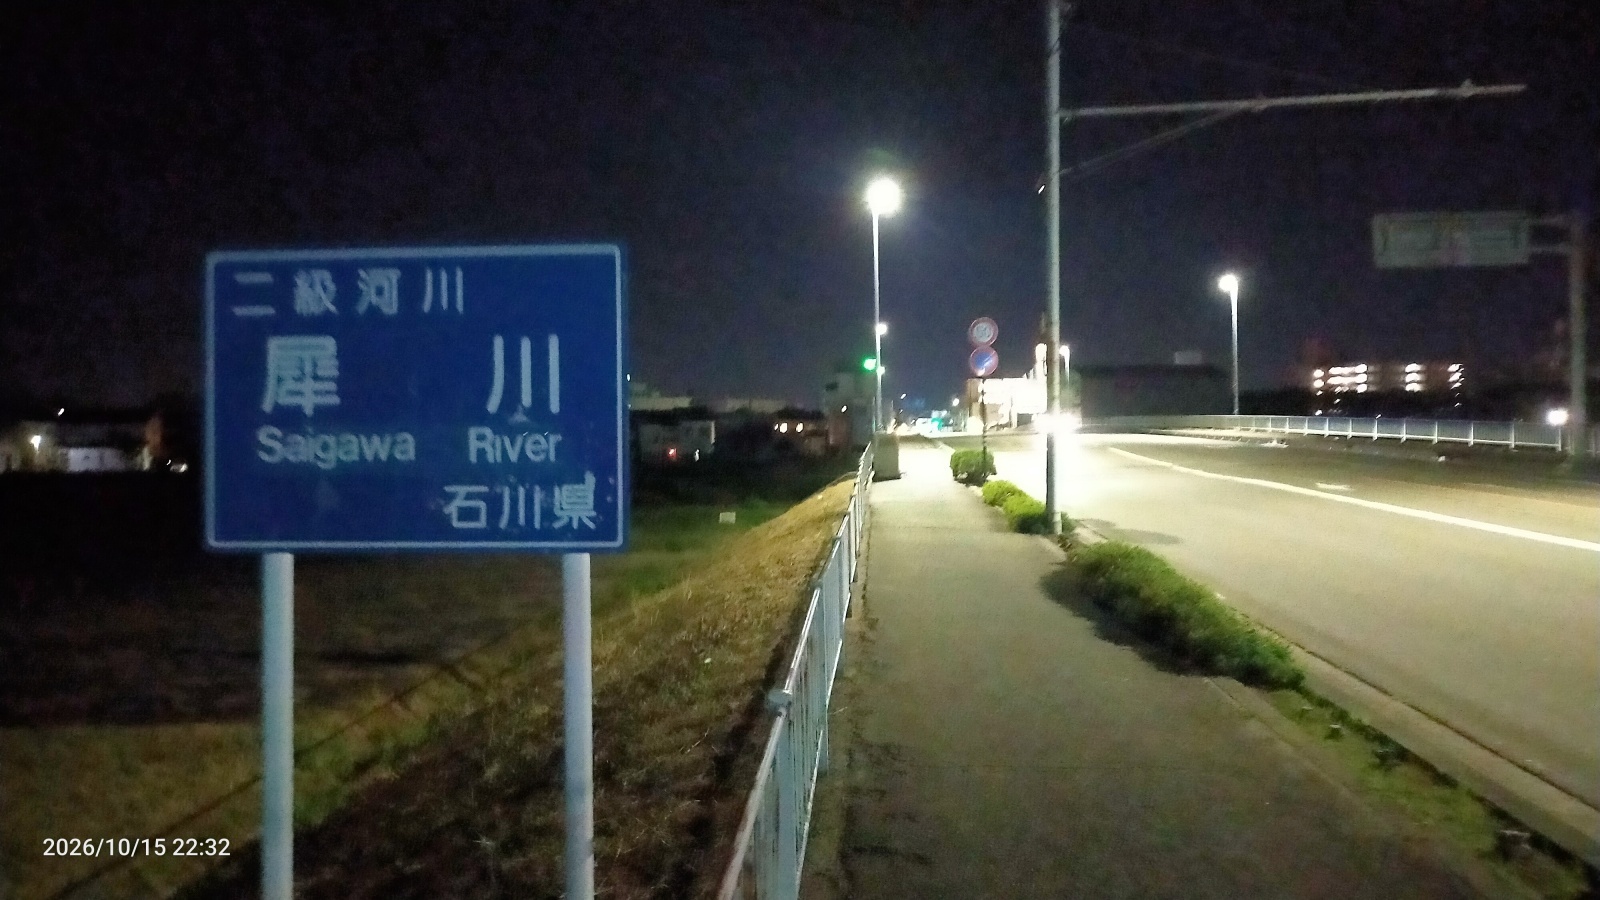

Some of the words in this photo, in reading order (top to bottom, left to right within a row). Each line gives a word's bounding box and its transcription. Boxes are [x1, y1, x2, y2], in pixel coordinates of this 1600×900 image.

[233, 267, 464, 316] 二級河川
[257, 425, 416, 469] Saigawa
[468, 426, 561, 463] River
[443, 474, 597, 530] 石川県
